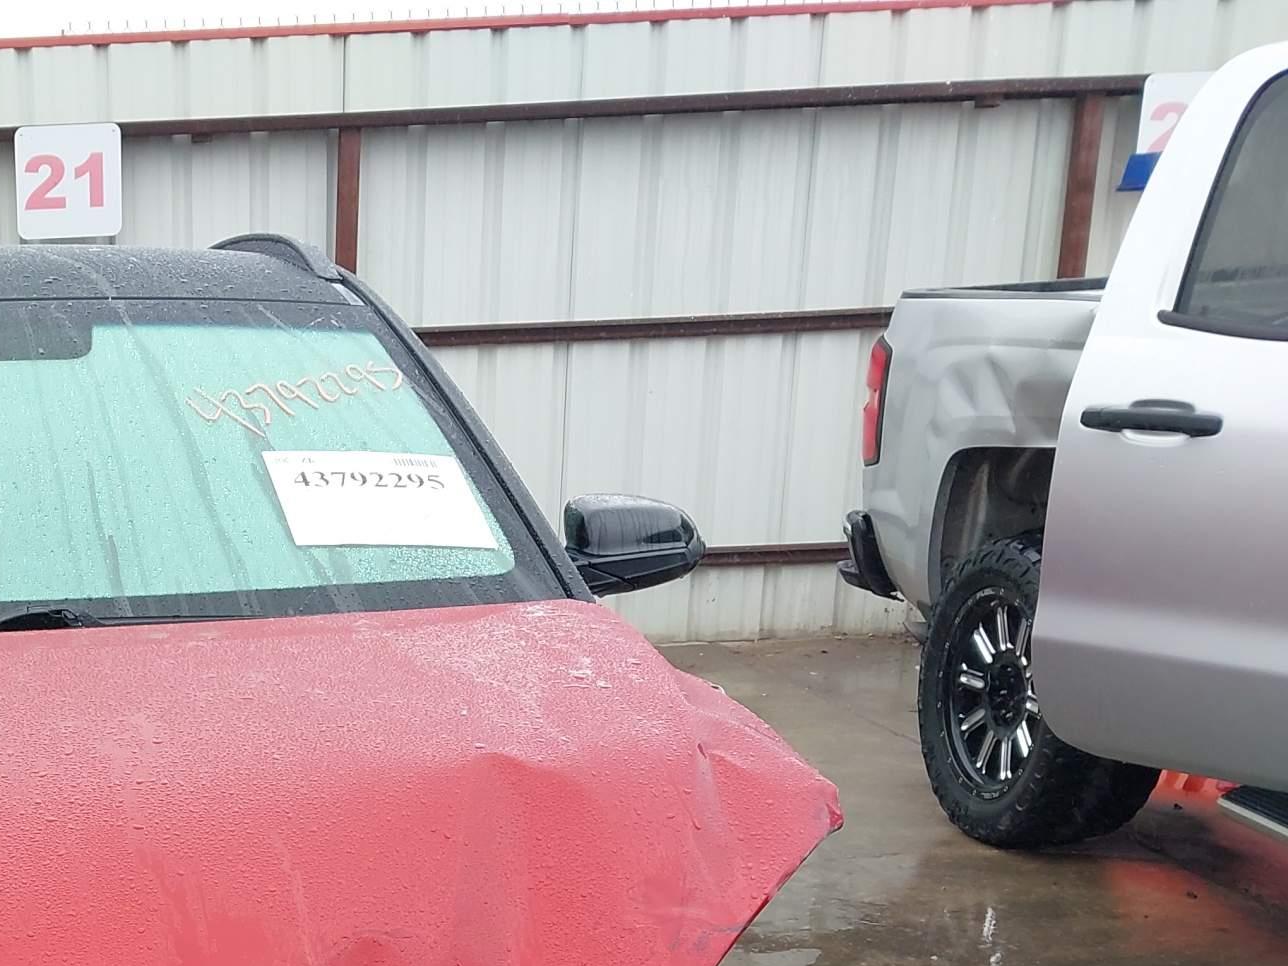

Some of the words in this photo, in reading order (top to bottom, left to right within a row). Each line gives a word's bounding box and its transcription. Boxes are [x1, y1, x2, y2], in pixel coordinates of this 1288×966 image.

[24, 151, 104, 210] 21
[186, 361, 403, 437] 43792295
[294, 471, 445, 490] 43792295
